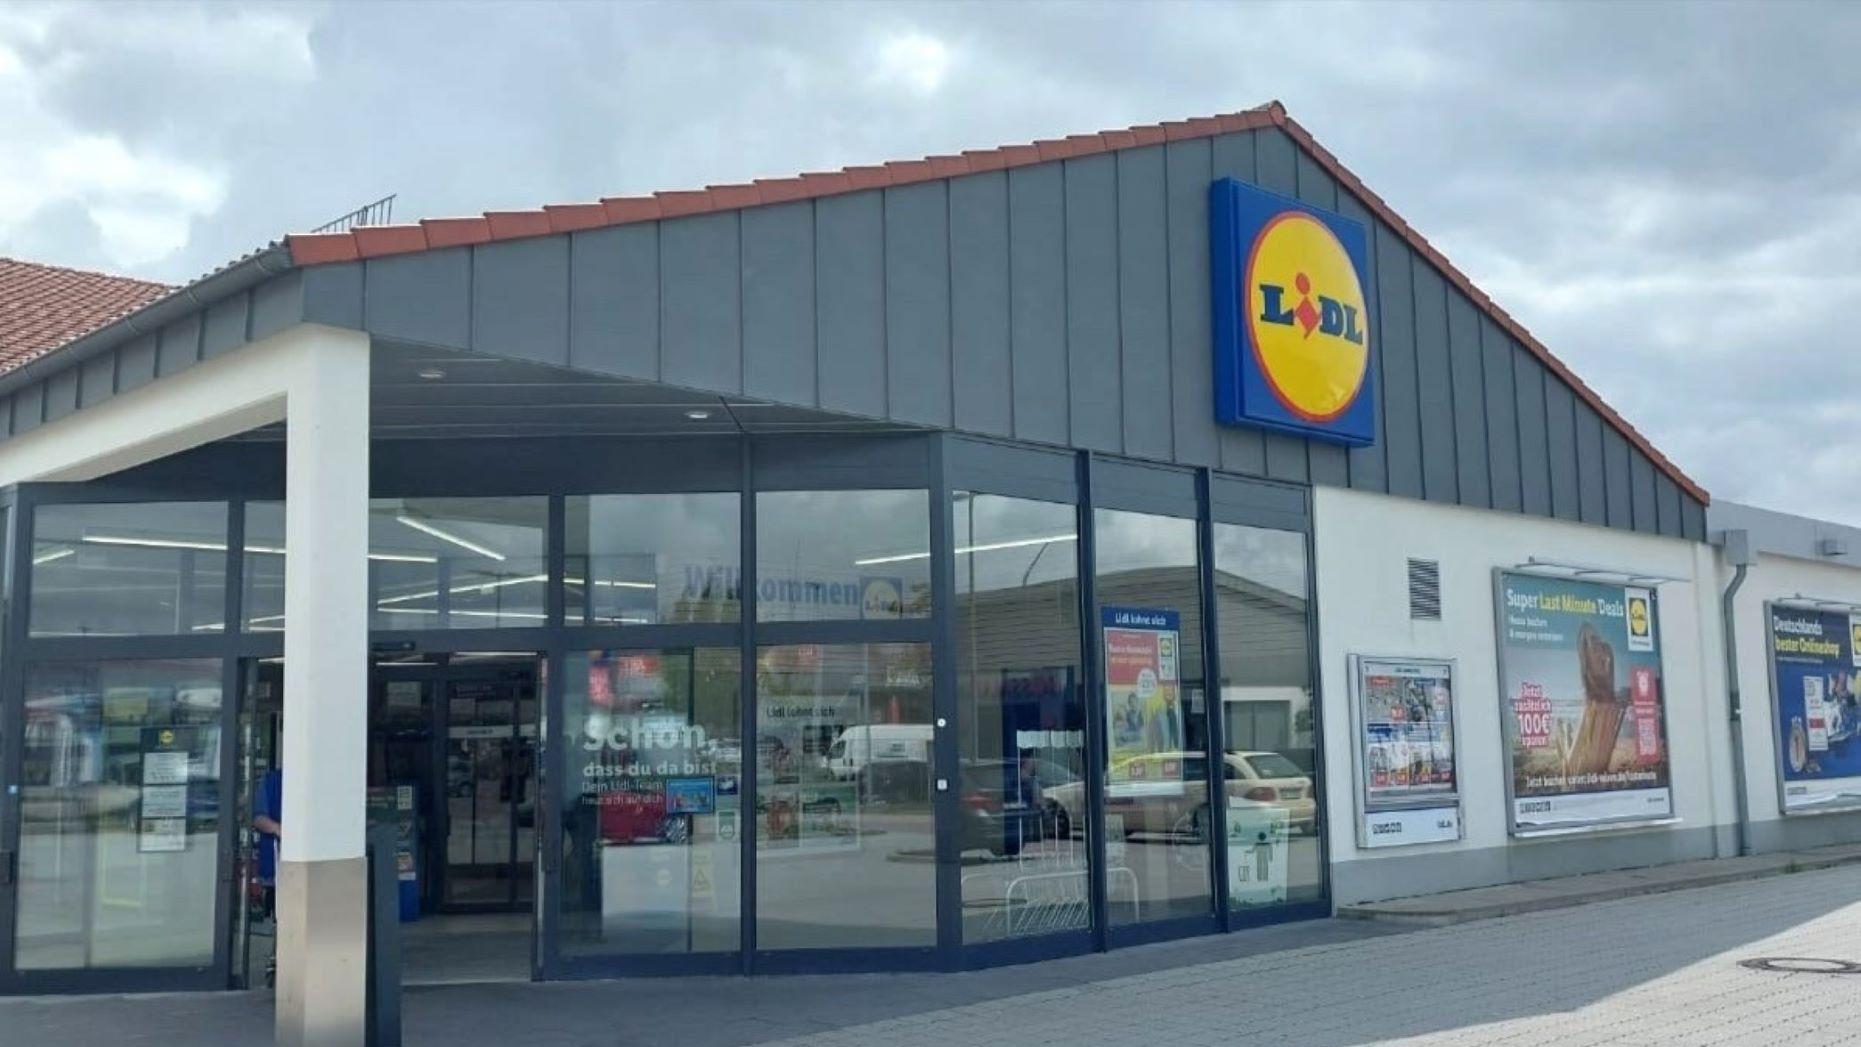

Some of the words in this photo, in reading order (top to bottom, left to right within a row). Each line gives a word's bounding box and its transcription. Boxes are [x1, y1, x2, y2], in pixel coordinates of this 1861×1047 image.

[1506, 588, 1538, 612] Super
[1539, 592, 1561, 610] Last
[1562, 594, 1597, 614] Minute
[1598, 599, 1624, 617] Deals
[1773, 614, 1823, 636] Deutschlands
[1775, 634, 1799, 652] bester
[1518, 713, 1551, 734] 100€
[583, 762, 625, 777] dass
[628, 760, 652, 776] du
[656, 760, 679, 775] da
[683, 760, 717, 775] bist
